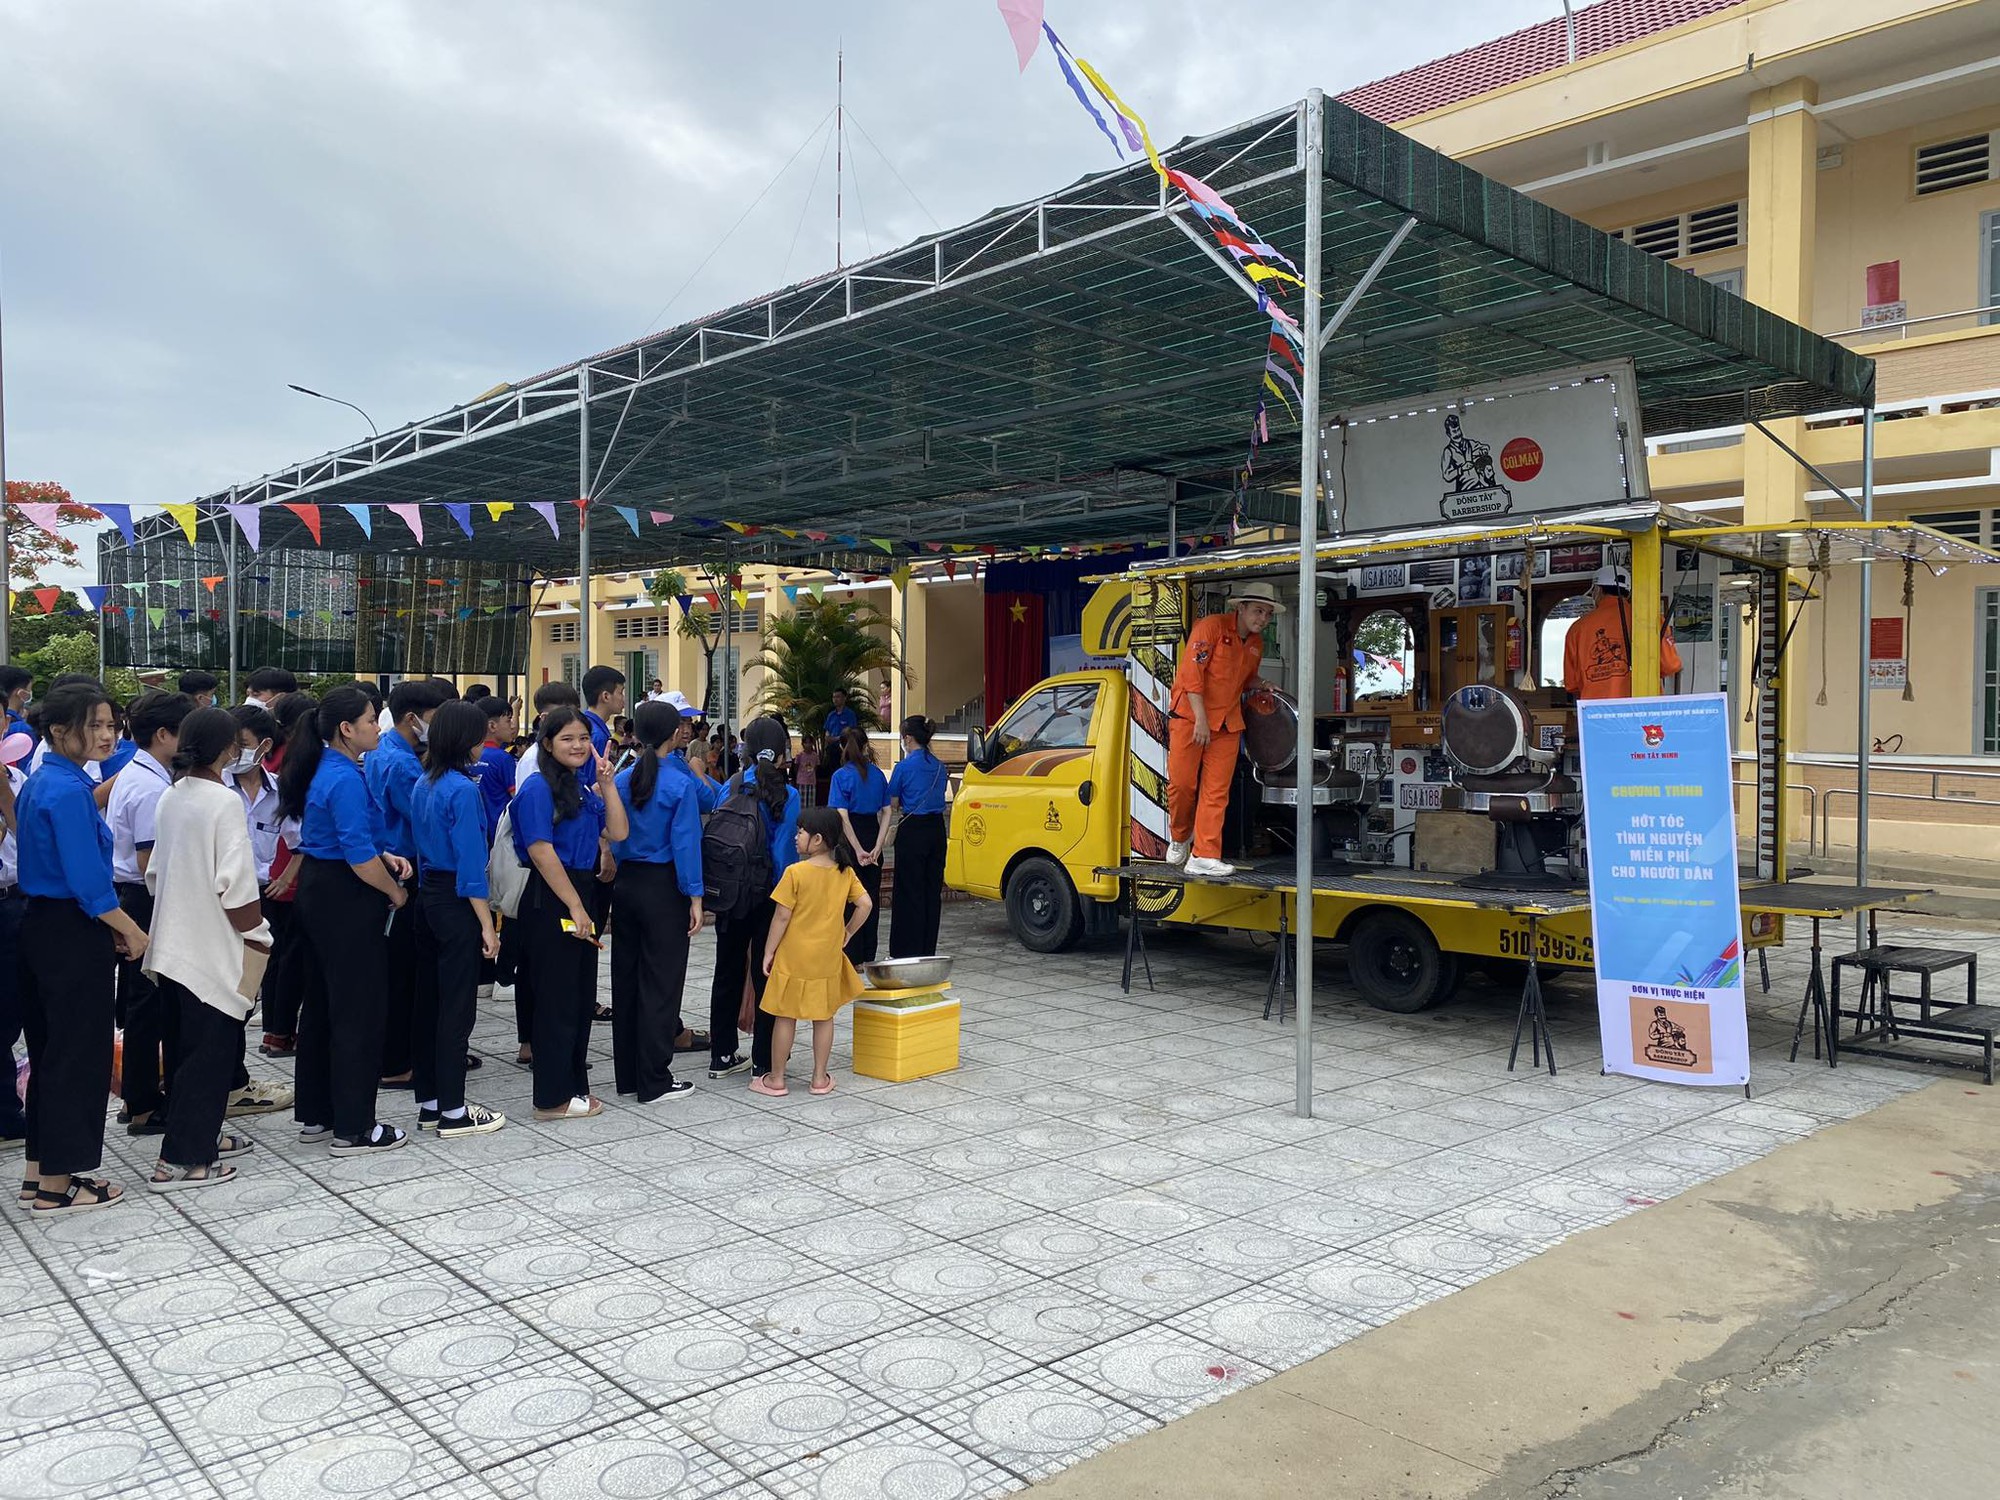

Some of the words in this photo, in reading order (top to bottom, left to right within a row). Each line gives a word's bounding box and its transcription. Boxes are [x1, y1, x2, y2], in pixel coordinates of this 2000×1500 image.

[1456, 496, 1478, 505] ĐÔNG
[1479, 492, 1493, 501] TÂY
[1452, 503, 1502, 516] BARBERSHOP
[1363, 570, 1378, 587] USA
[1403, 789, 1418, 805] USA
[1424, 789, 1441, 806] 188
[1631, 813, 1656, 828] HỚT
[1659, 813, 1685, 828] TÓC
[1616, 830, 1646, 845] TÌNH
[1649, 830, 1703, 848] NGUYỆN
[1667, 848, 1690, 863] PHÍ
[1611, 865, 1636, 878] CHO
[1640, 864, 1680, 880] NGƯỜI
[1684, 865, 1713, 880] DÂN
[1632, 985, 1649, 994] ĐƠN
[1650, 986, 1659, 997] VỊ
[1661, 987, 1682, 999] THỰC
[1684, 989, 1705, 1000] HIỆN
